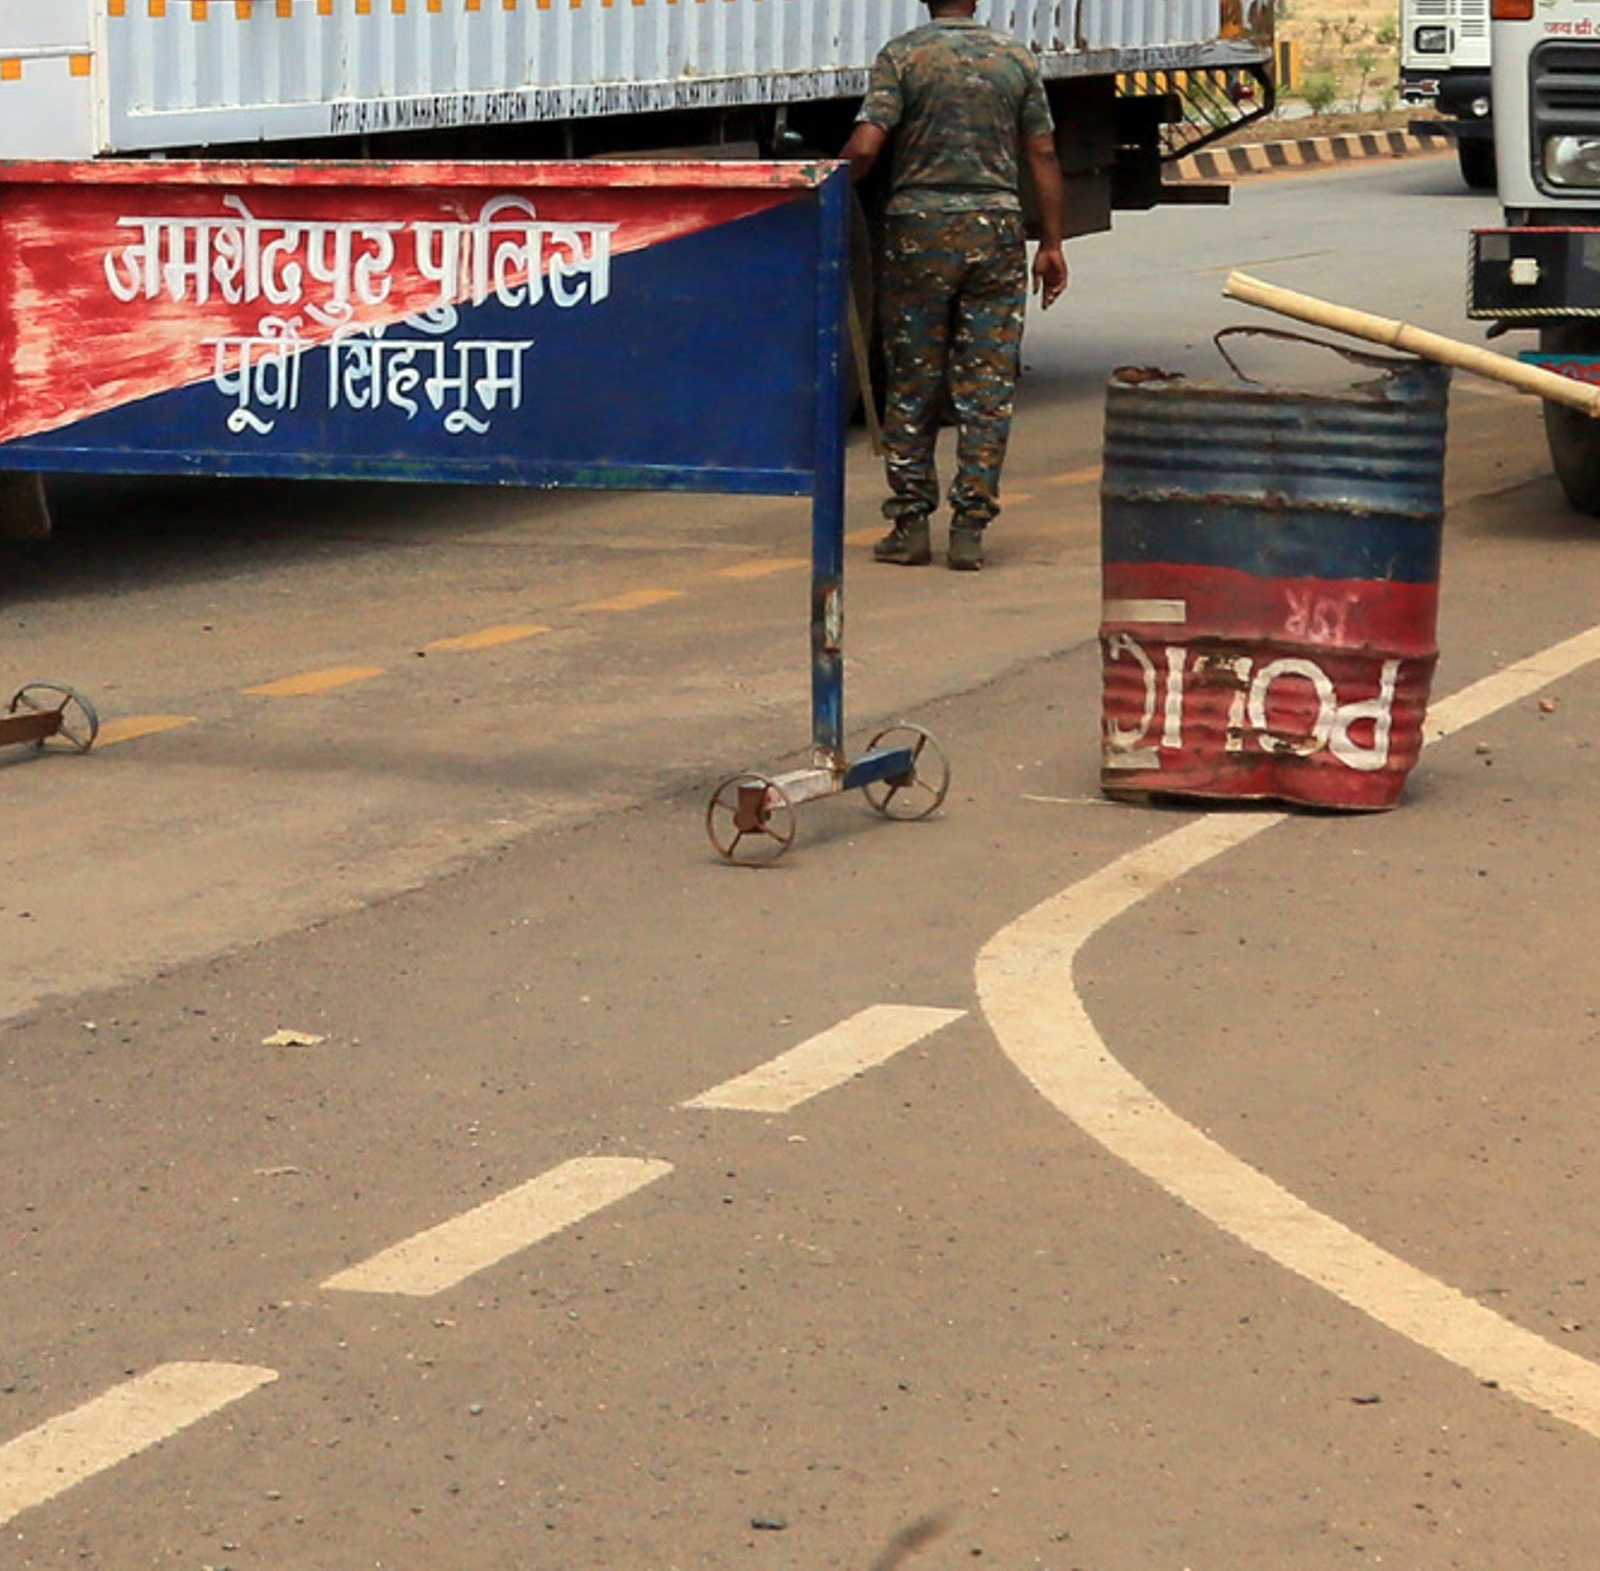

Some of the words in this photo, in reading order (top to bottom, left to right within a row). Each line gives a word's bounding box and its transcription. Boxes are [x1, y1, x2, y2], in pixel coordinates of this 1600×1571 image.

[104, 194, 406, 324] जमशेदपुर
[404, 195, 621, 333] पुलिस
[200, 315, 318, 434] पूर्वी
[320, 323, 534, 434] सिंहभूम
